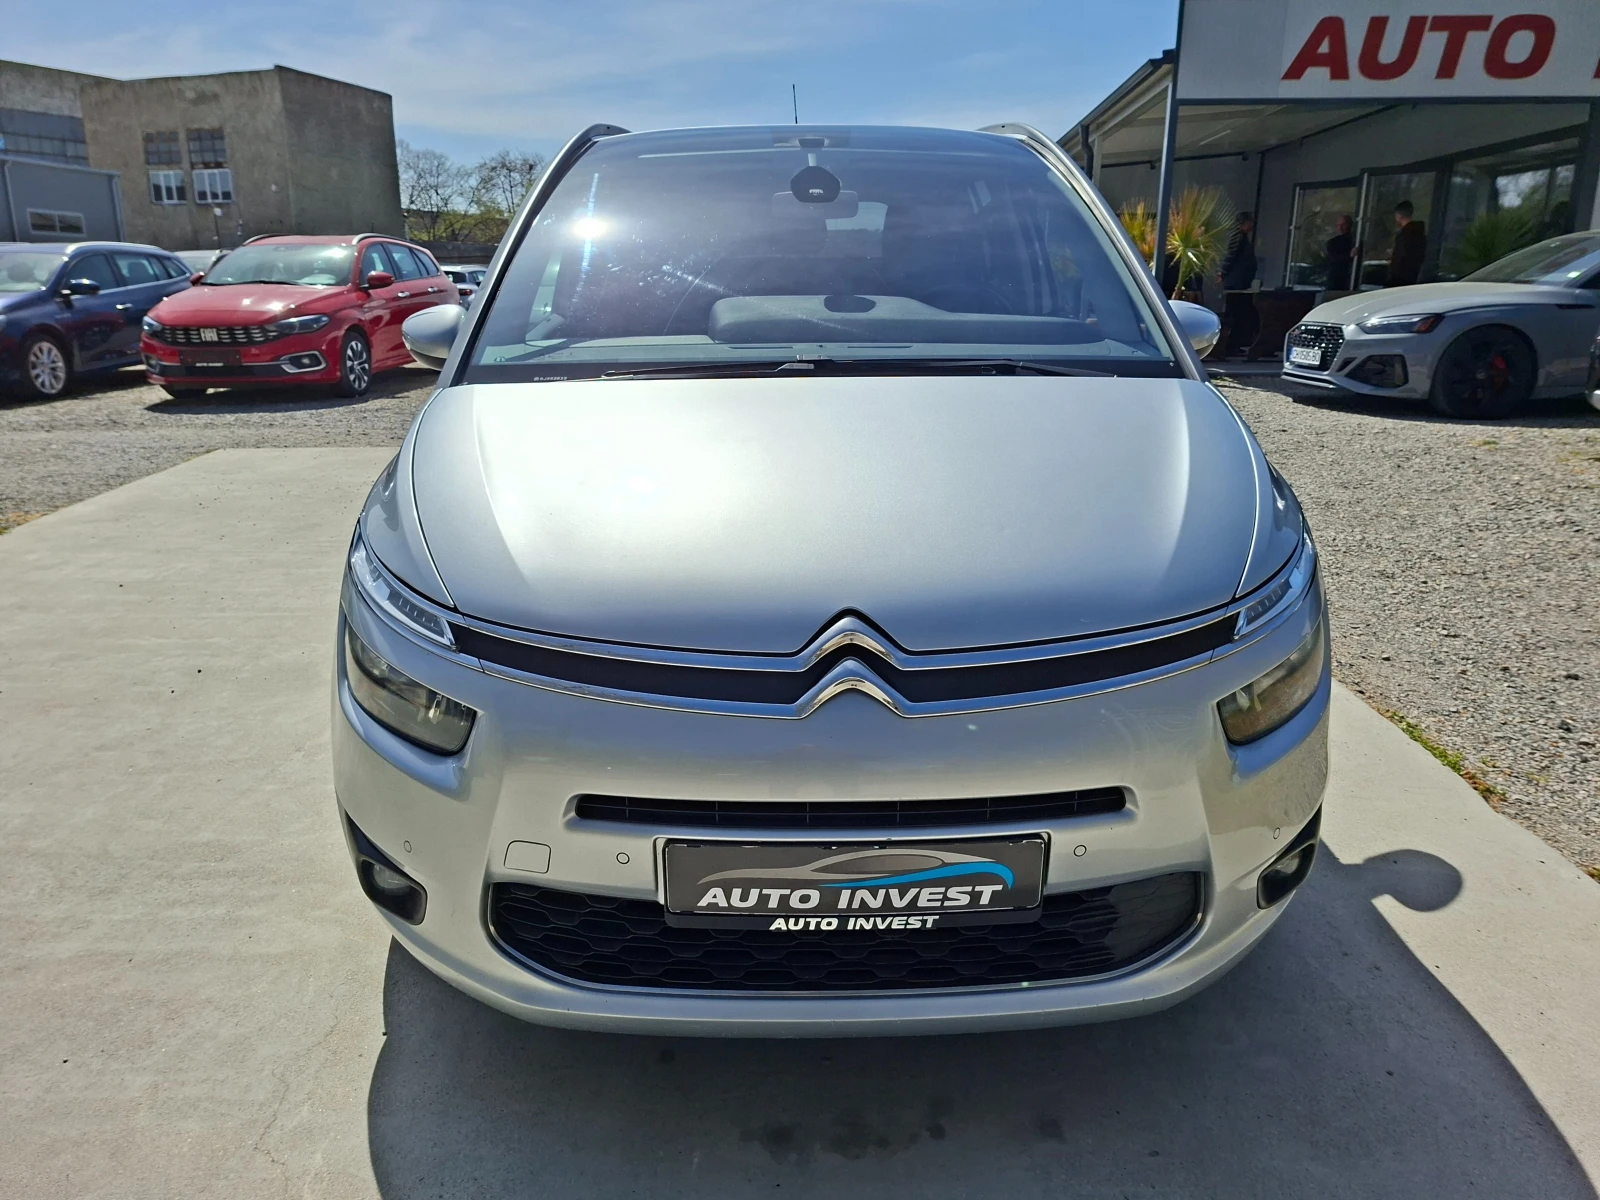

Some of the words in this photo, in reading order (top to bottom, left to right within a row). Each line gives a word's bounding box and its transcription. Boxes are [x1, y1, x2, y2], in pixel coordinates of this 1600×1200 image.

[1281, 14, 1556, 81] AUTO
[697, 887, 821, 909] AUTO
[837, 885, 1003, 909] INVEST
[769, 917, 839, 930] AUTO
[847, 916, 939, 930] INVEST
